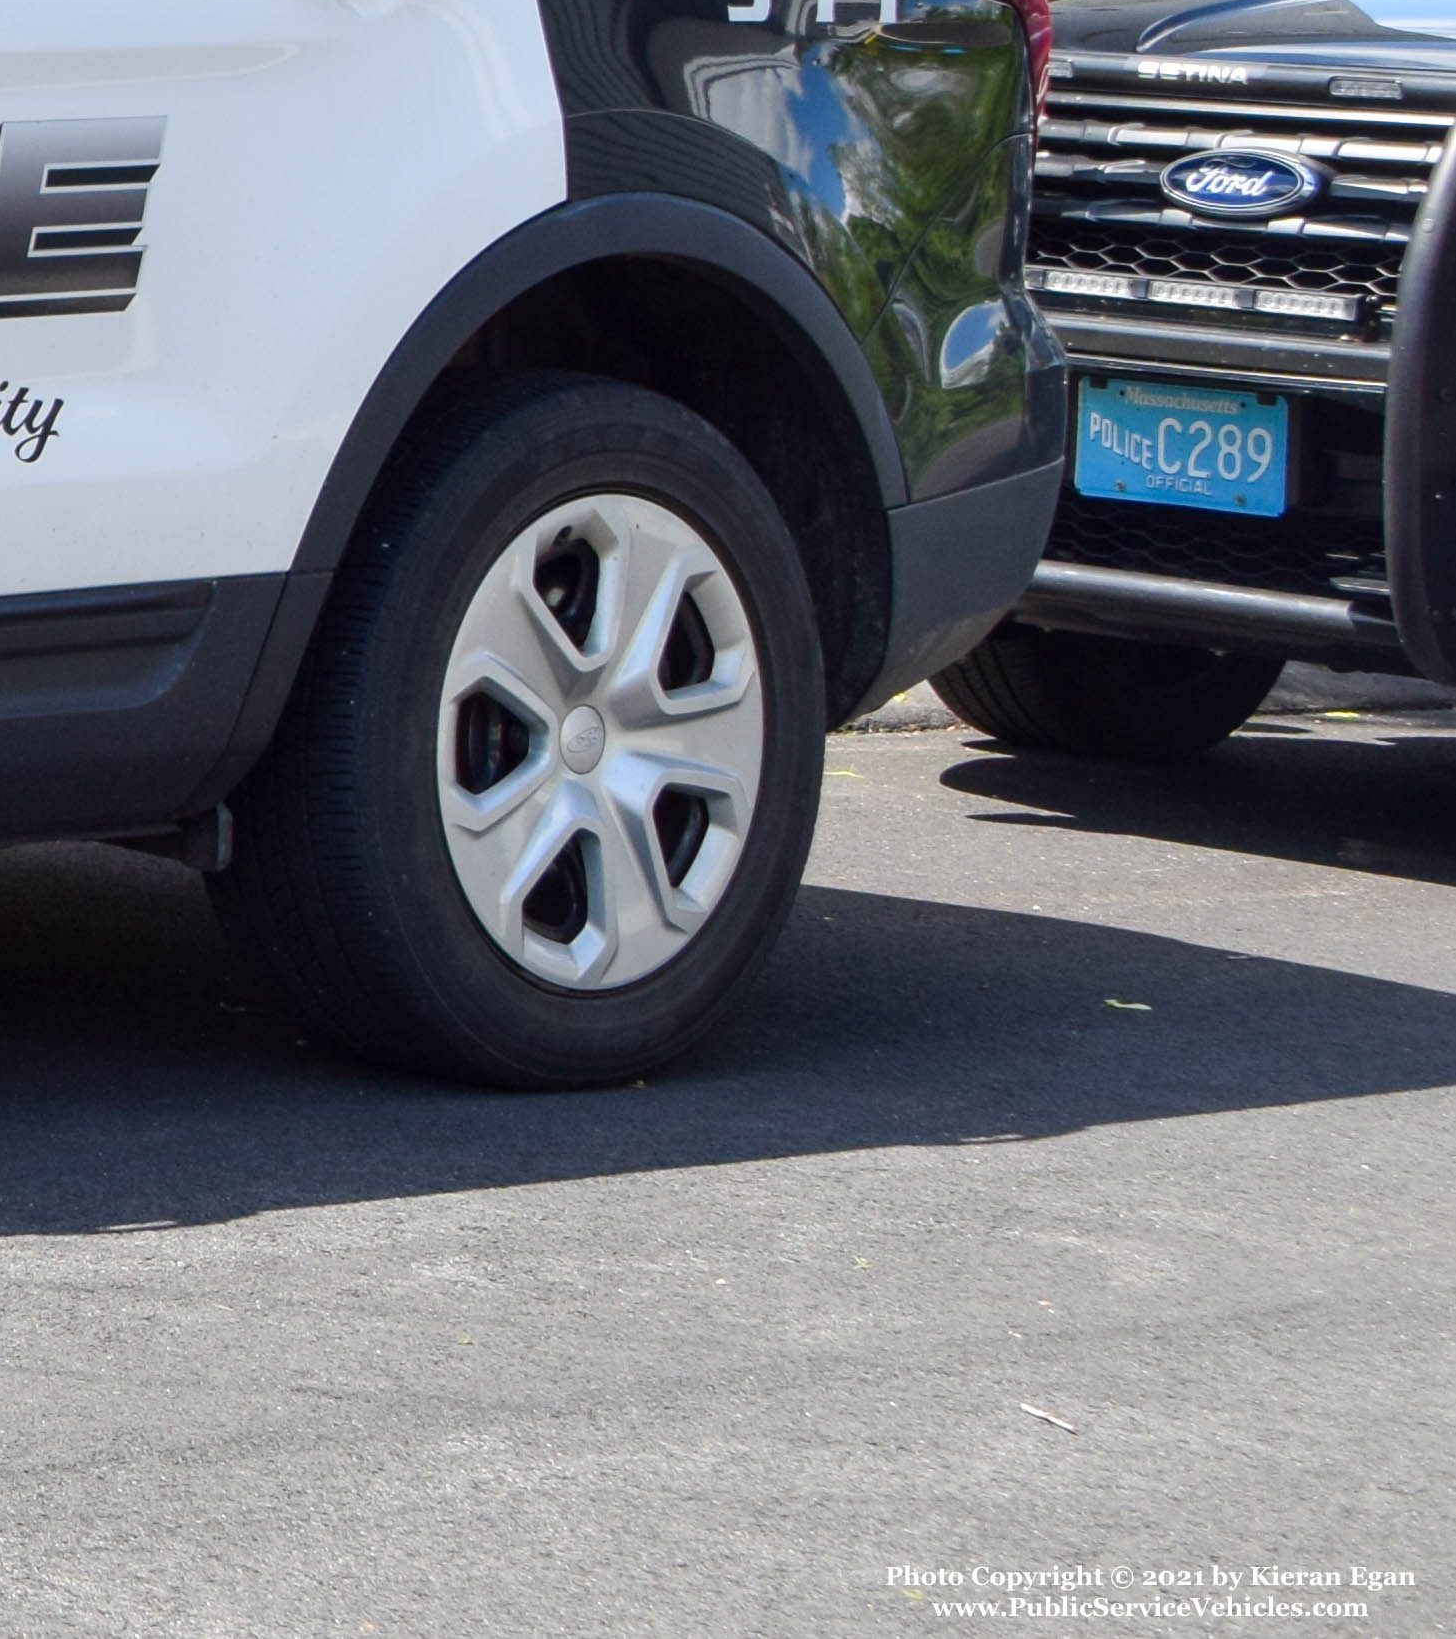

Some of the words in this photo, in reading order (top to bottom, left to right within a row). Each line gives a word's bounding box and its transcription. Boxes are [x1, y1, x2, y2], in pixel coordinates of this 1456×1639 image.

[1185, 160, 1275, 197] Ford
[1089, 412, 1156, 471] POLICE
[1157, 417, 1273, 483] C289
[1145, 474, 1213, 496] OFFICIAL
